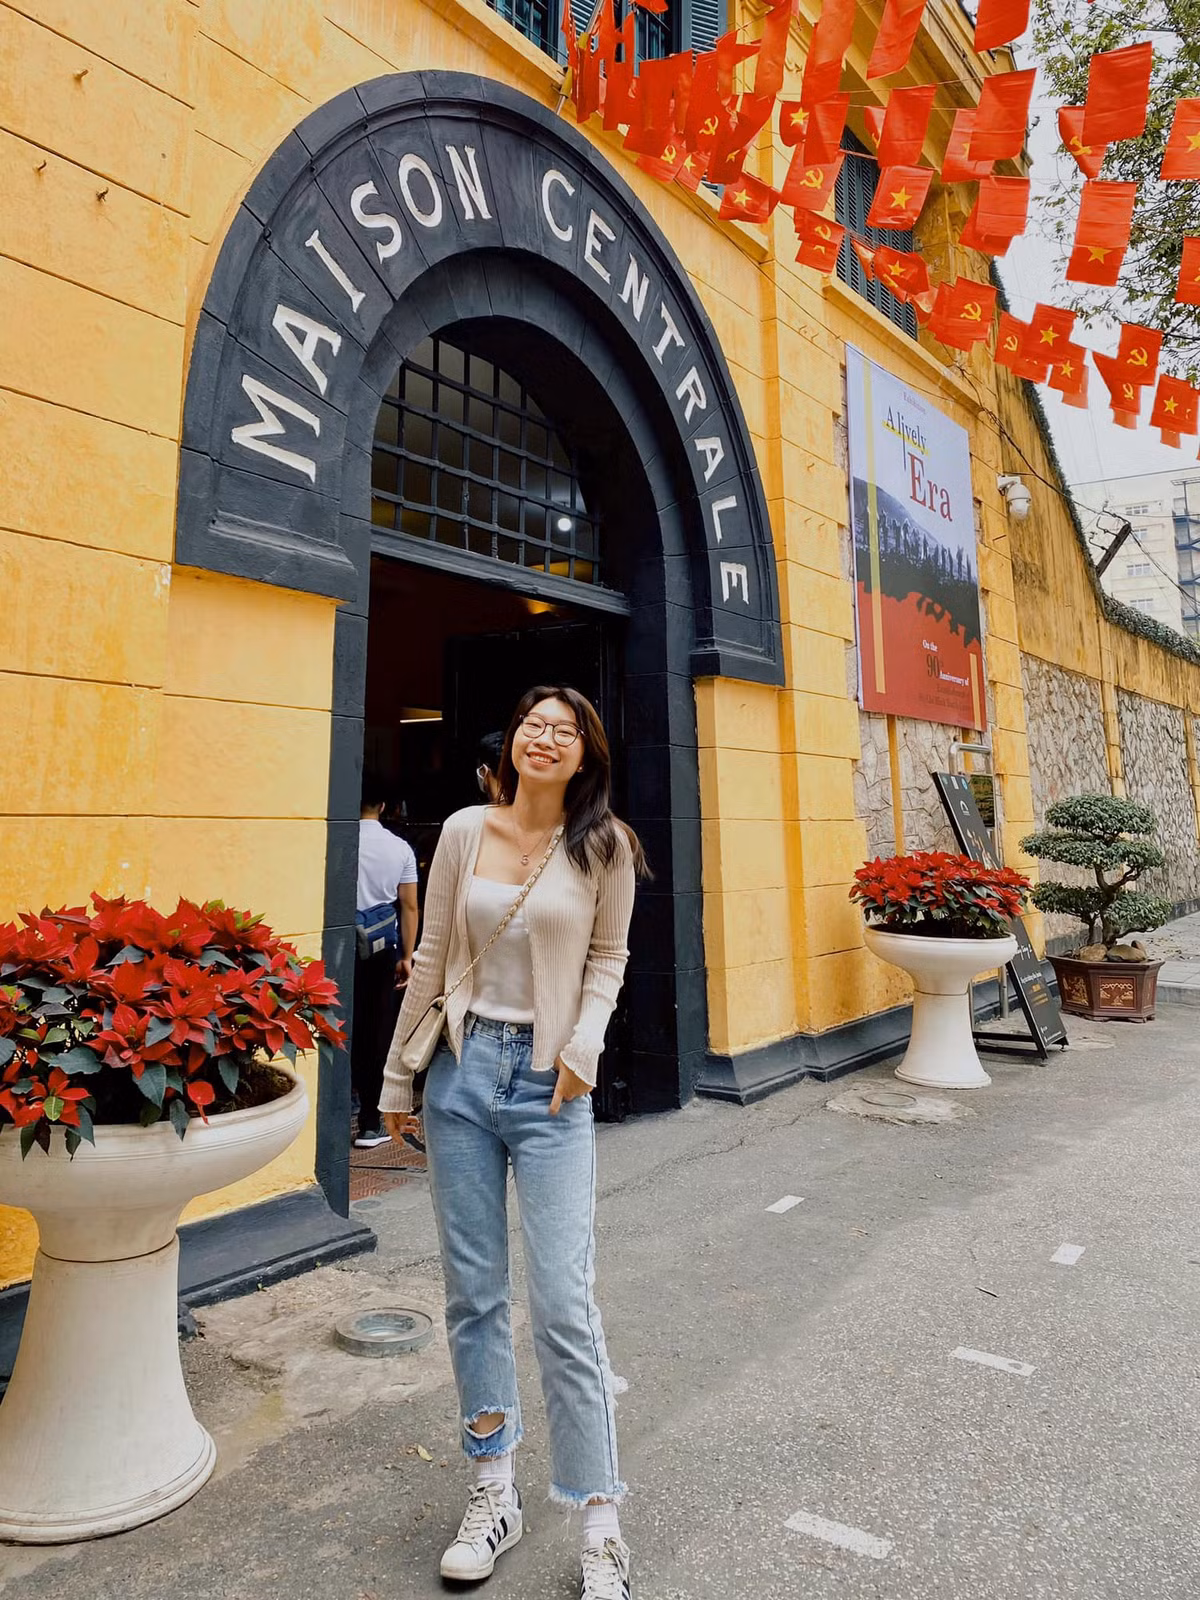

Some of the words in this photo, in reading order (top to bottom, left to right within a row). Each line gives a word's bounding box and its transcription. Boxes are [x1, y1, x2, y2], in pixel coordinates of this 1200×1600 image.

[230, 144, 492, 484] MAISON
[540, 168, 749, 605] CENTRALE
[907, 451, 953, 522] Era
